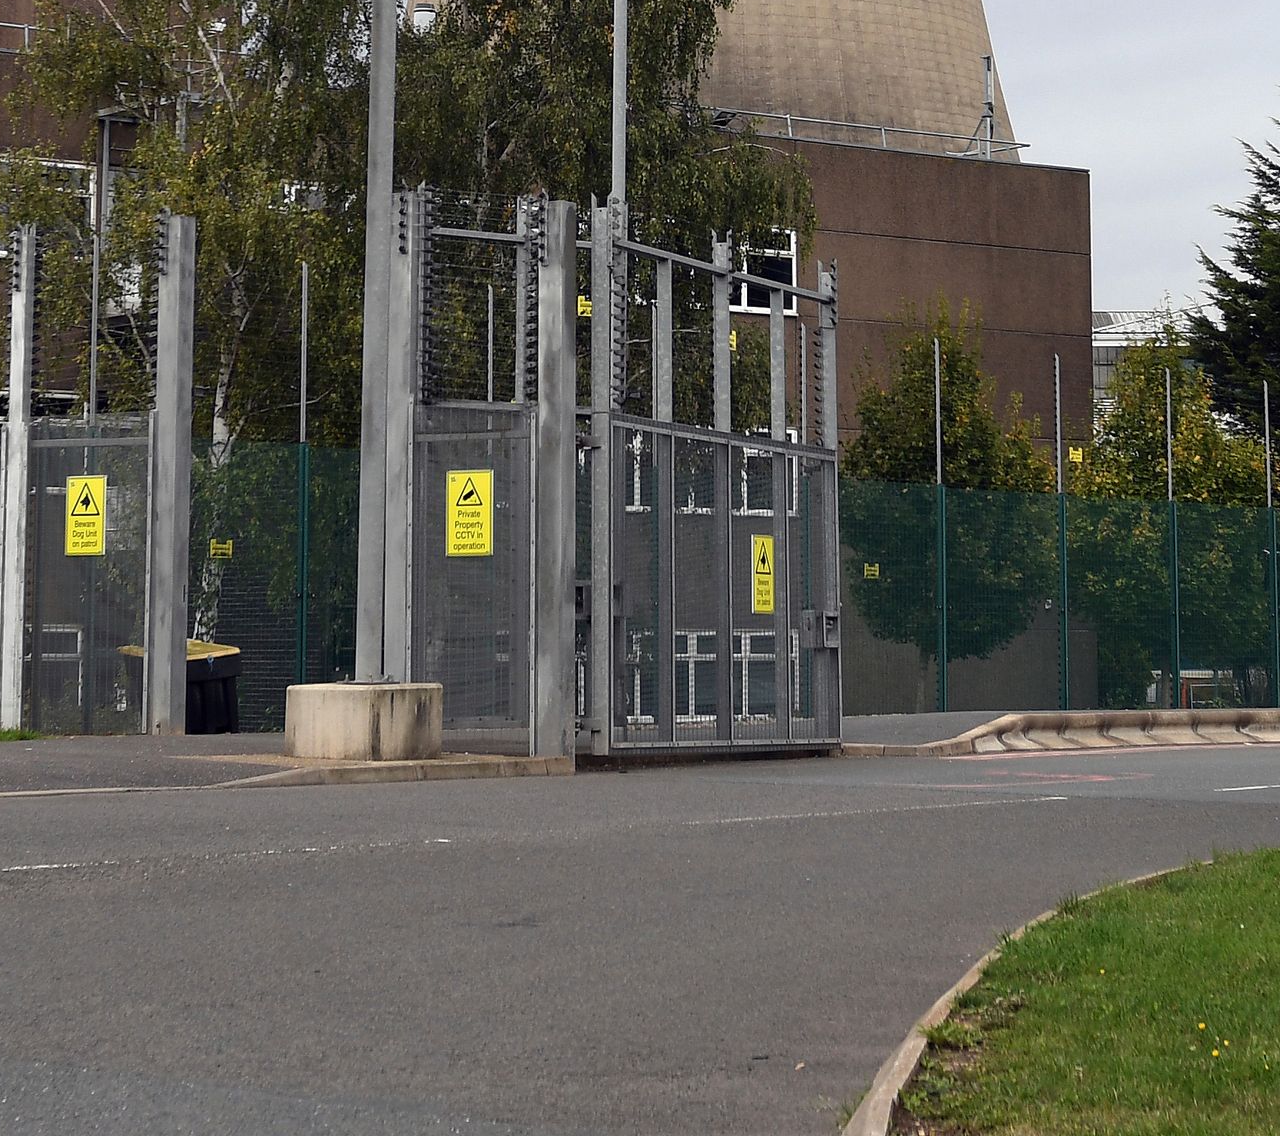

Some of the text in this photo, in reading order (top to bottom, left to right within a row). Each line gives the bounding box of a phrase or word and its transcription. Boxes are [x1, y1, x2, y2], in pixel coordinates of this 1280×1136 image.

[457, 510, 481, 518] Private
[74, 520, 96, 528] Beware
[454, 521, 484, 530] Property
[72, 530, 84, 539] Dog
[453, 542, 485, 551] operation
